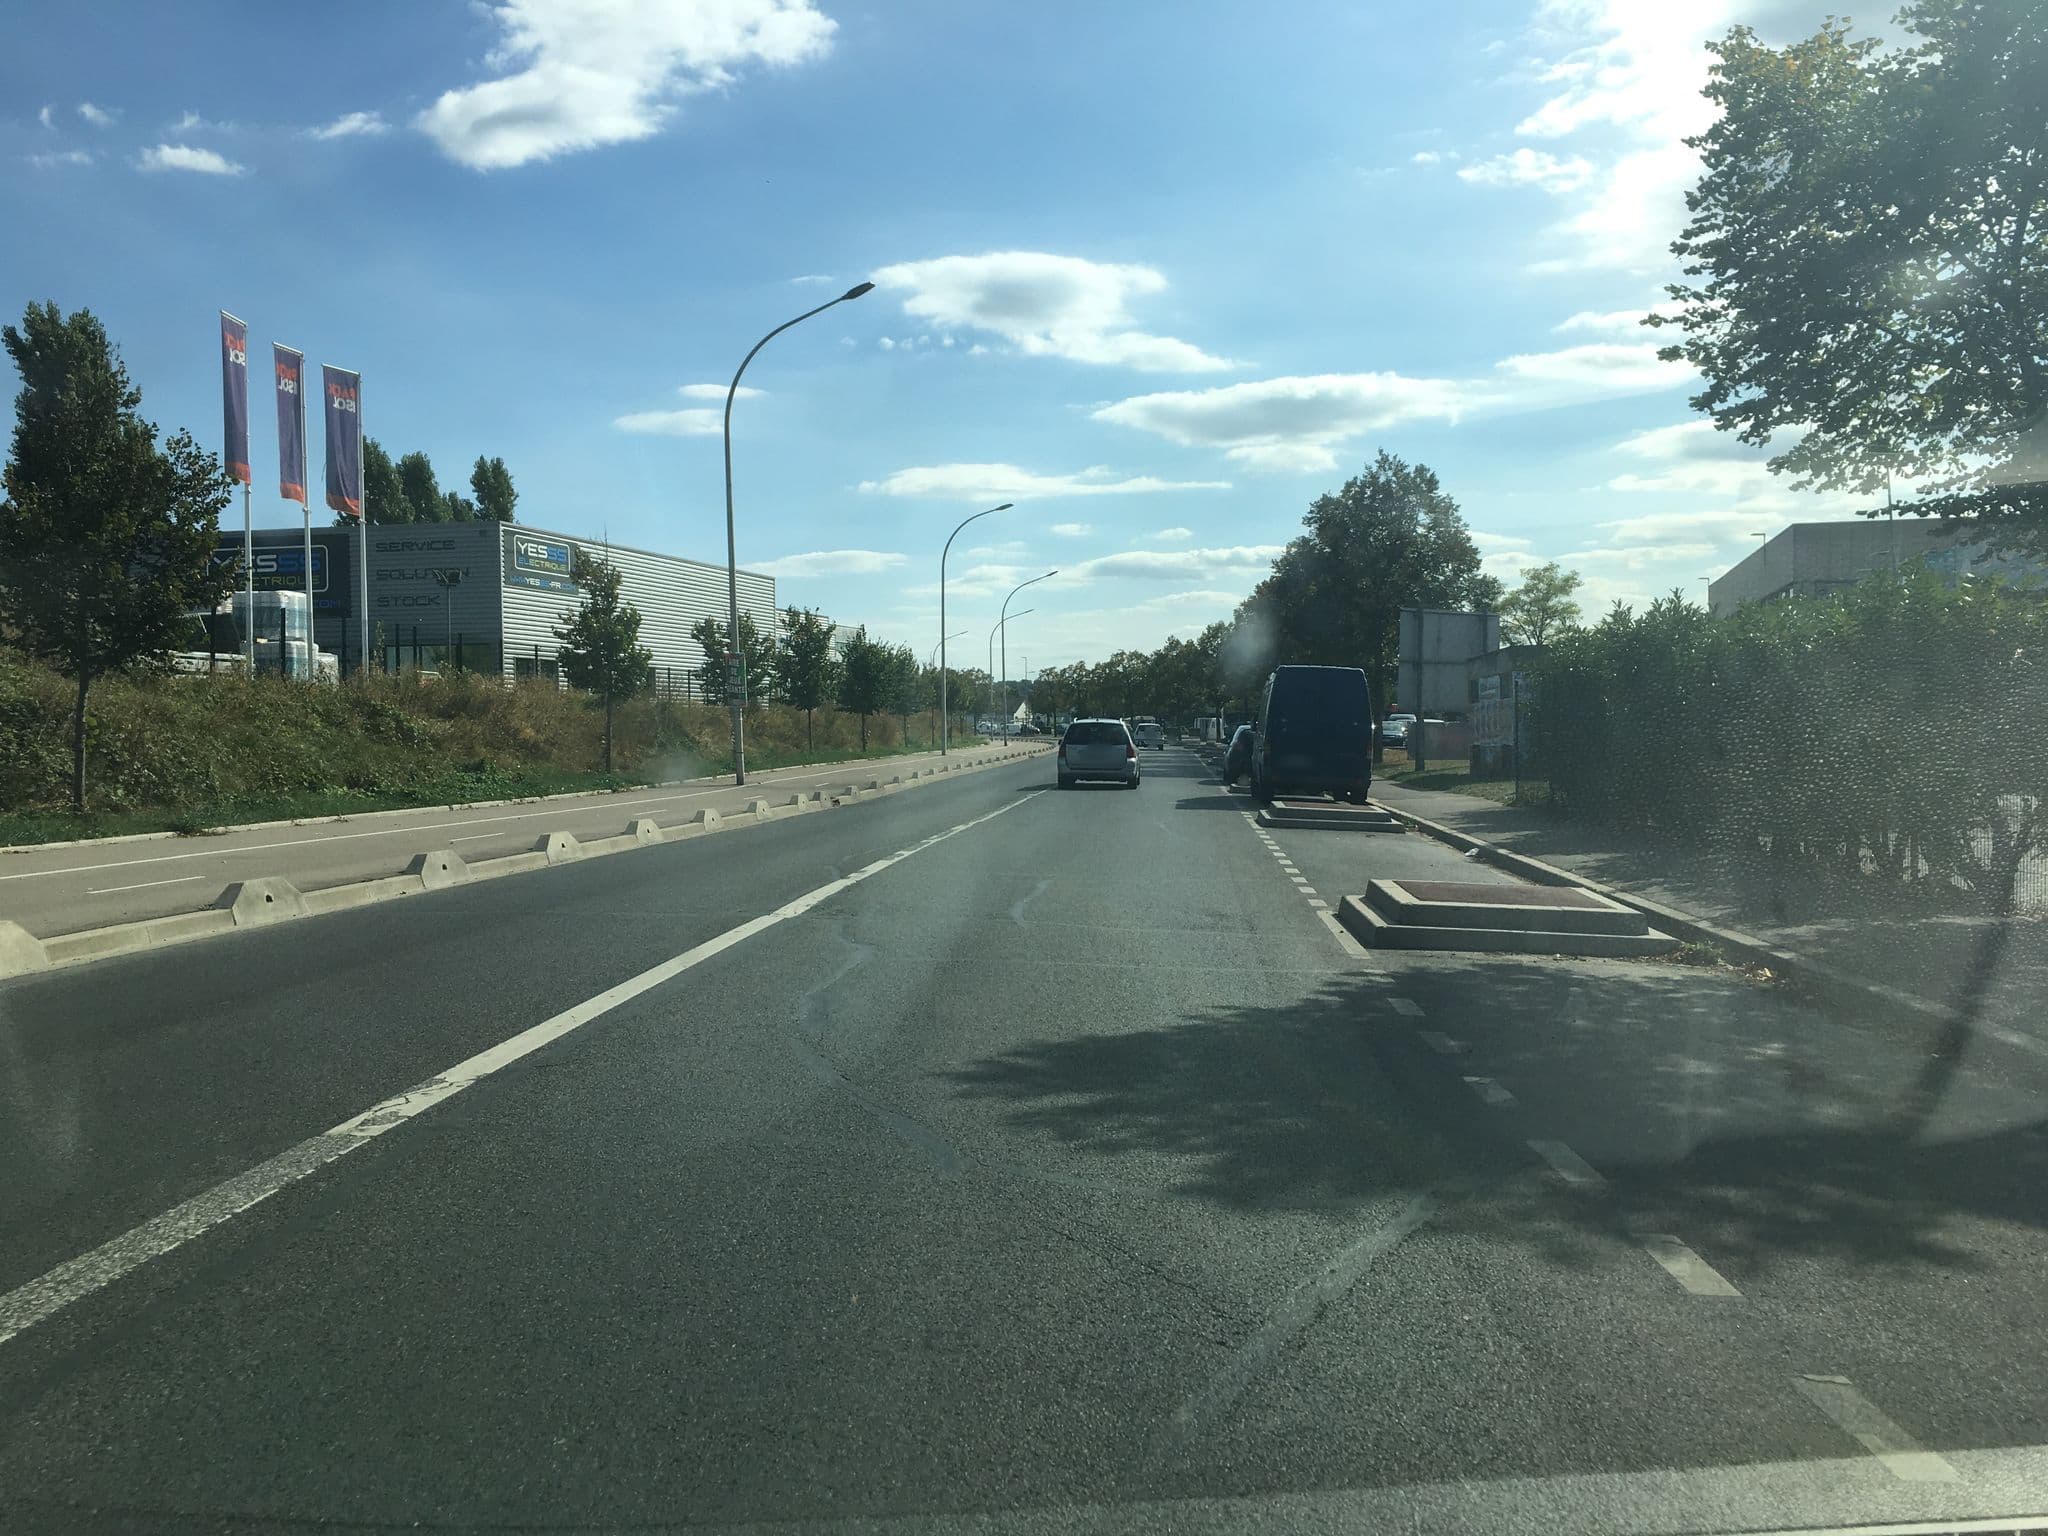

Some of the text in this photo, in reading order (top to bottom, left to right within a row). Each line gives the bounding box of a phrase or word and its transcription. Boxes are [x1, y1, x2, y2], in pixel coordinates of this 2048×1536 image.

[375, 540, 455, 552] SERVICE
[517, 541, 567, 562] YESSS
[377, 595, 440, 608] STOCK
